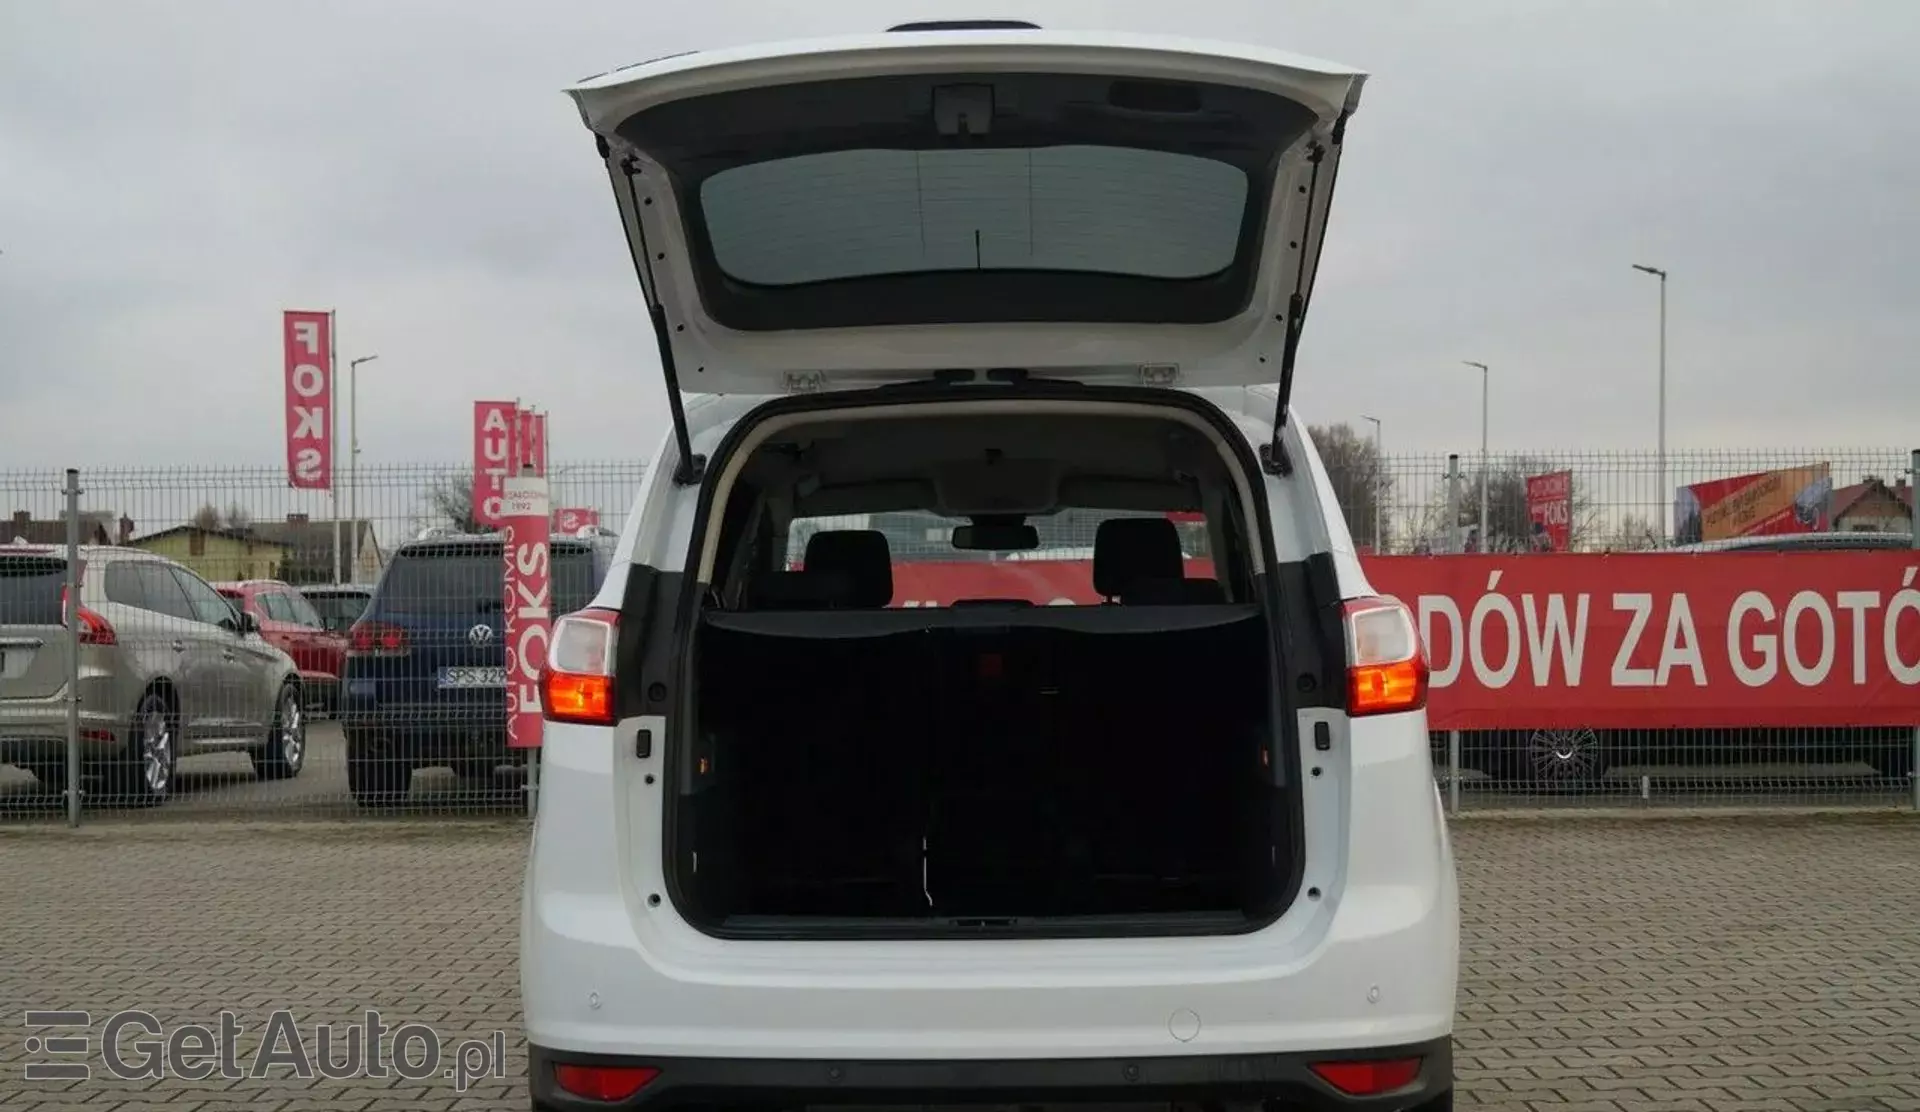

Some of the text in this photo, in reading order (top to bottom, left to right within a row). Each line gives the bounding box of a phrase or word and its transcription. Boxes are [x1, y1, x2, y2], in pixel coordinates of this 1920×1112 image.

[503, 525, 518, 740] AUTO KOMIS
[517, 542, 548, 713] FOKS
[1380, 566, 1920, 689] DÓW ZA GOTÓ
